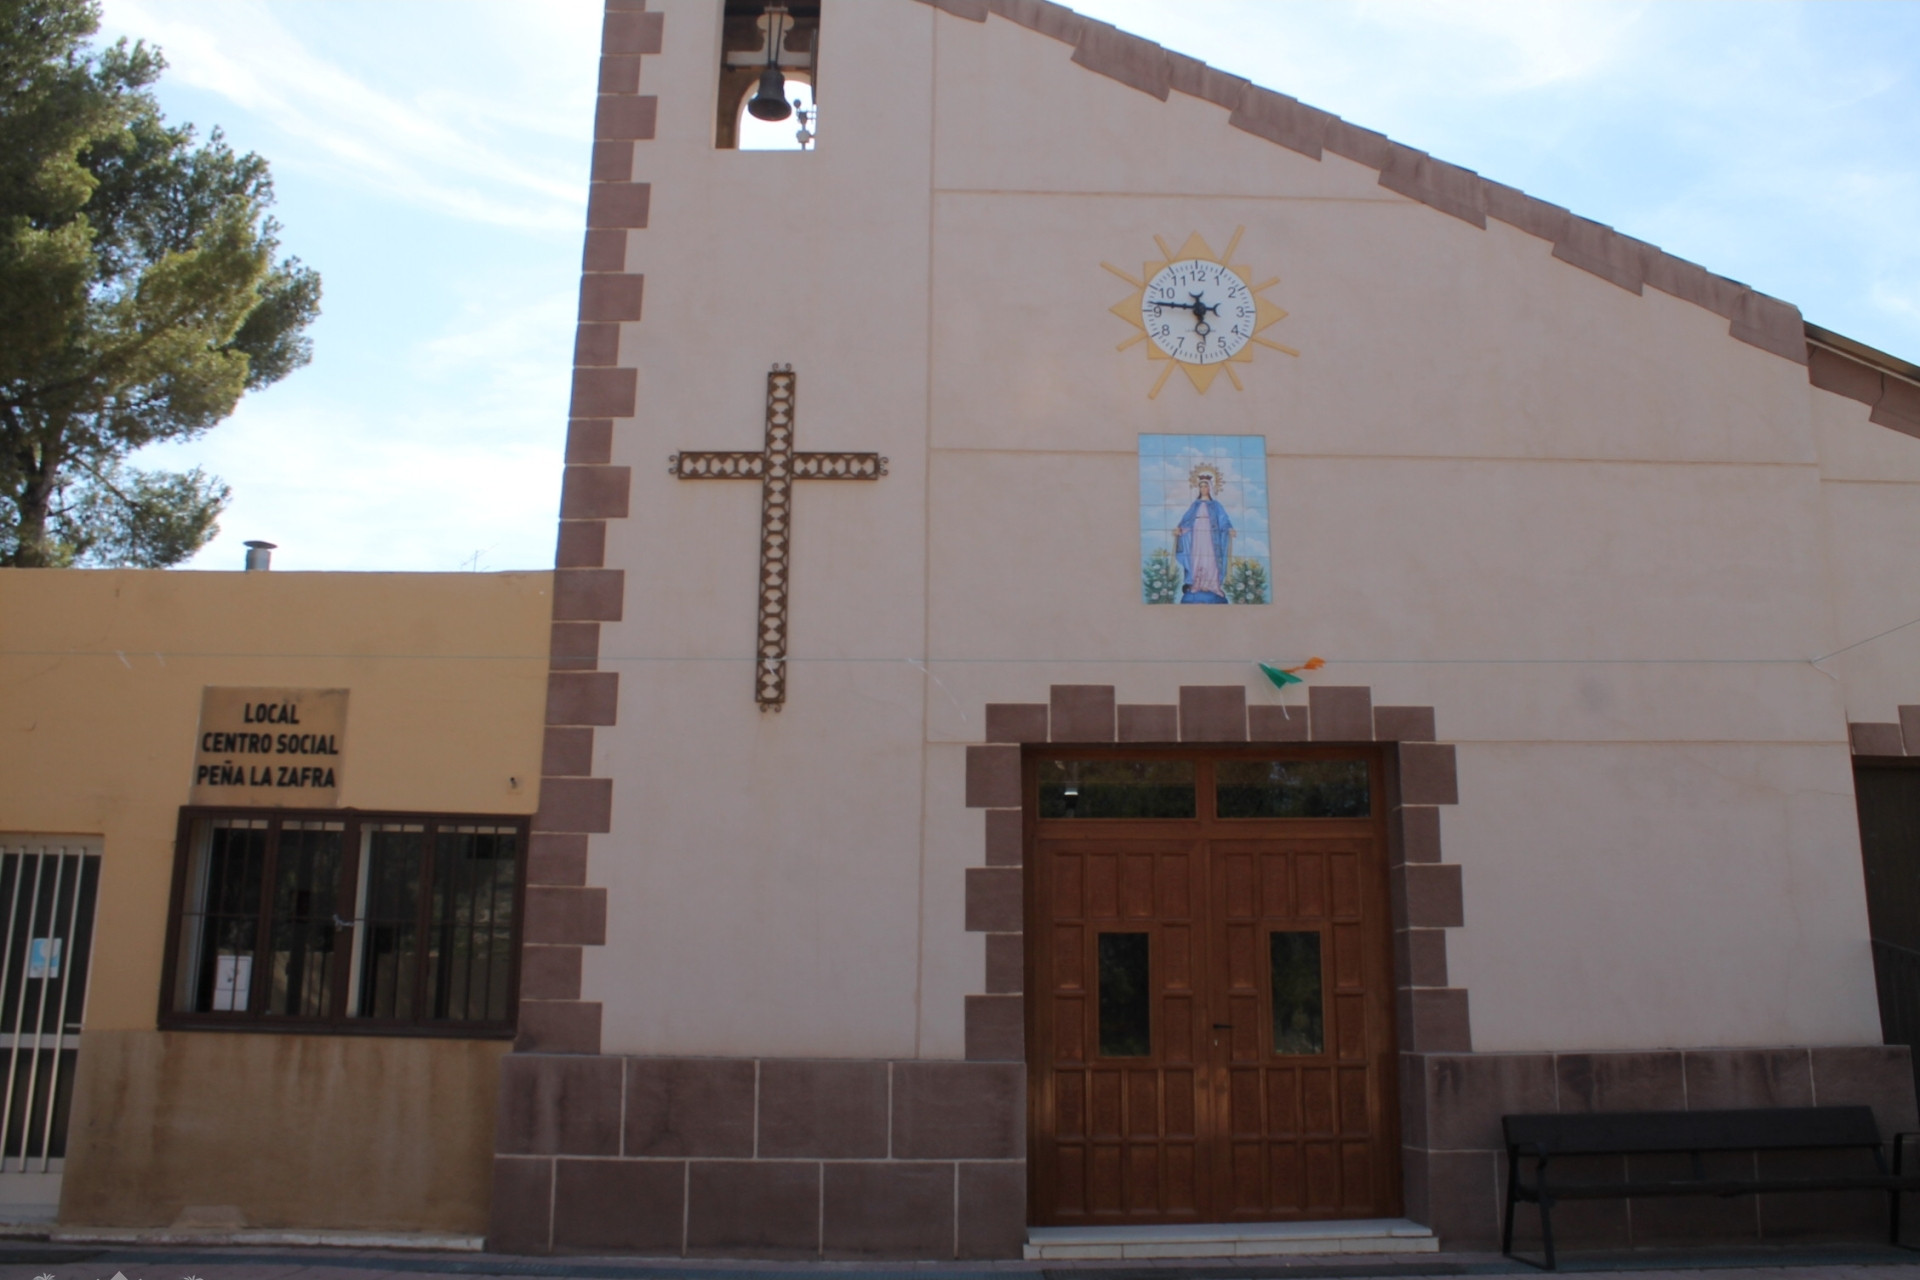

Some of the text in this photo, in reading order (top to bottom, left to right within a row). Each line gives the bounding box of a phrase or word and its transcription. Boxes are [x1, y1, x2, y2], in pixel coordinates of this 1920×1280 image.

[1171, 275, 1186, 287] 11
[1190, 270, 1206, 282] 12
[1214, 275, 1220, 287] 1
[1159, 287, 1175, 299] 10
[1227, 286, 1236, 299] 2
[1153, 305, 1162, 318] 9
[1236, 306, 1245, 318] 3
[1161, 324, 1170, 337] 8
[1230, 324, 1239, 335] 4
[1177, 337, 1185, 349] 7
[1196, 342, 1206, 354] 6
[1218, 337, 1227, 349] 5
[244, 702, 300, 725] LOCAL
[202, 732, 338, 755] CENTRO SOCIAL
[197, 760, 336, 788] PEÑA LA ZAFRA
